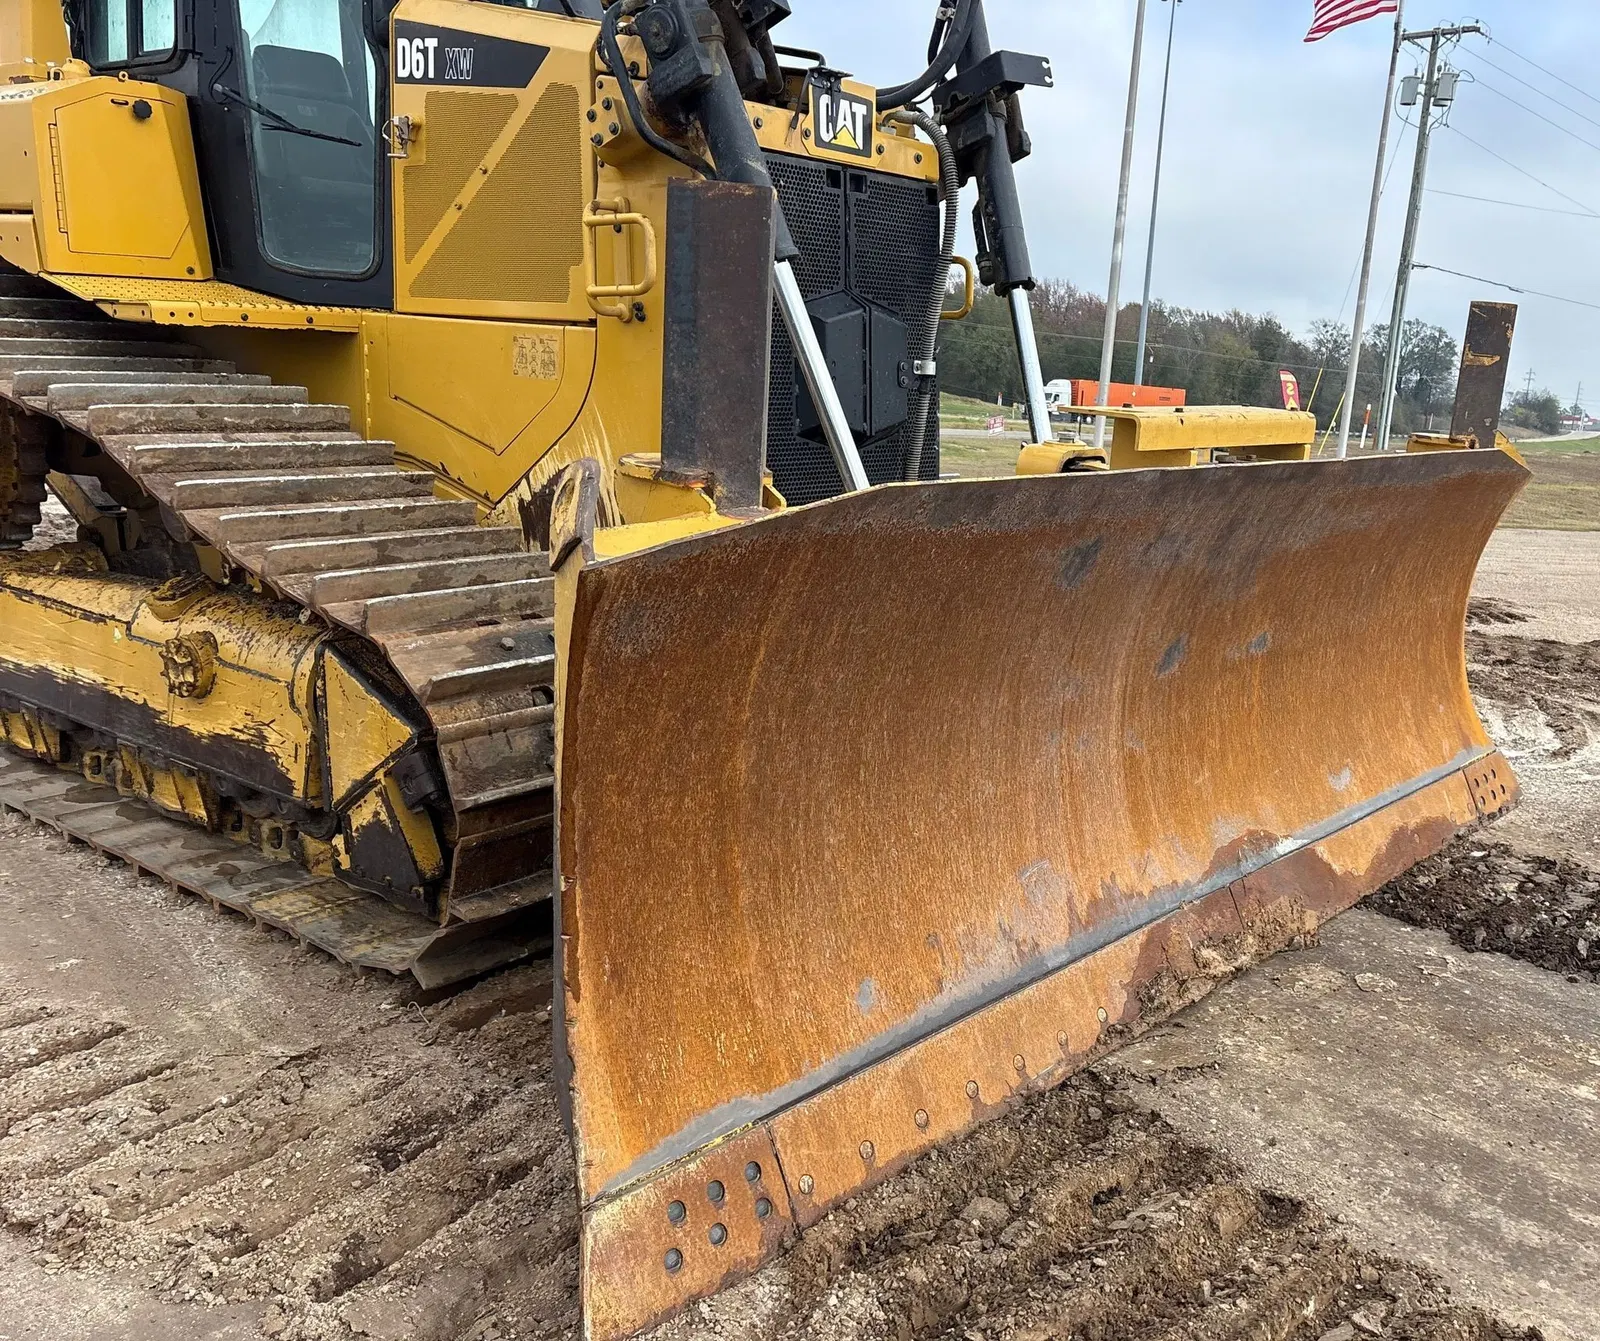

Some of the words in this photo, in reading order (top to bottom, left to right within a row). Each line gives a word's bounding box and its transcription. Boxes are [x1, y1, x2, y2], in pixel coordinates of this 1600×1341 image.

[397, 38, 438, 78] D6T
[445, 48, 473, 79] XW
[819, 94, 867, 150] CAT
